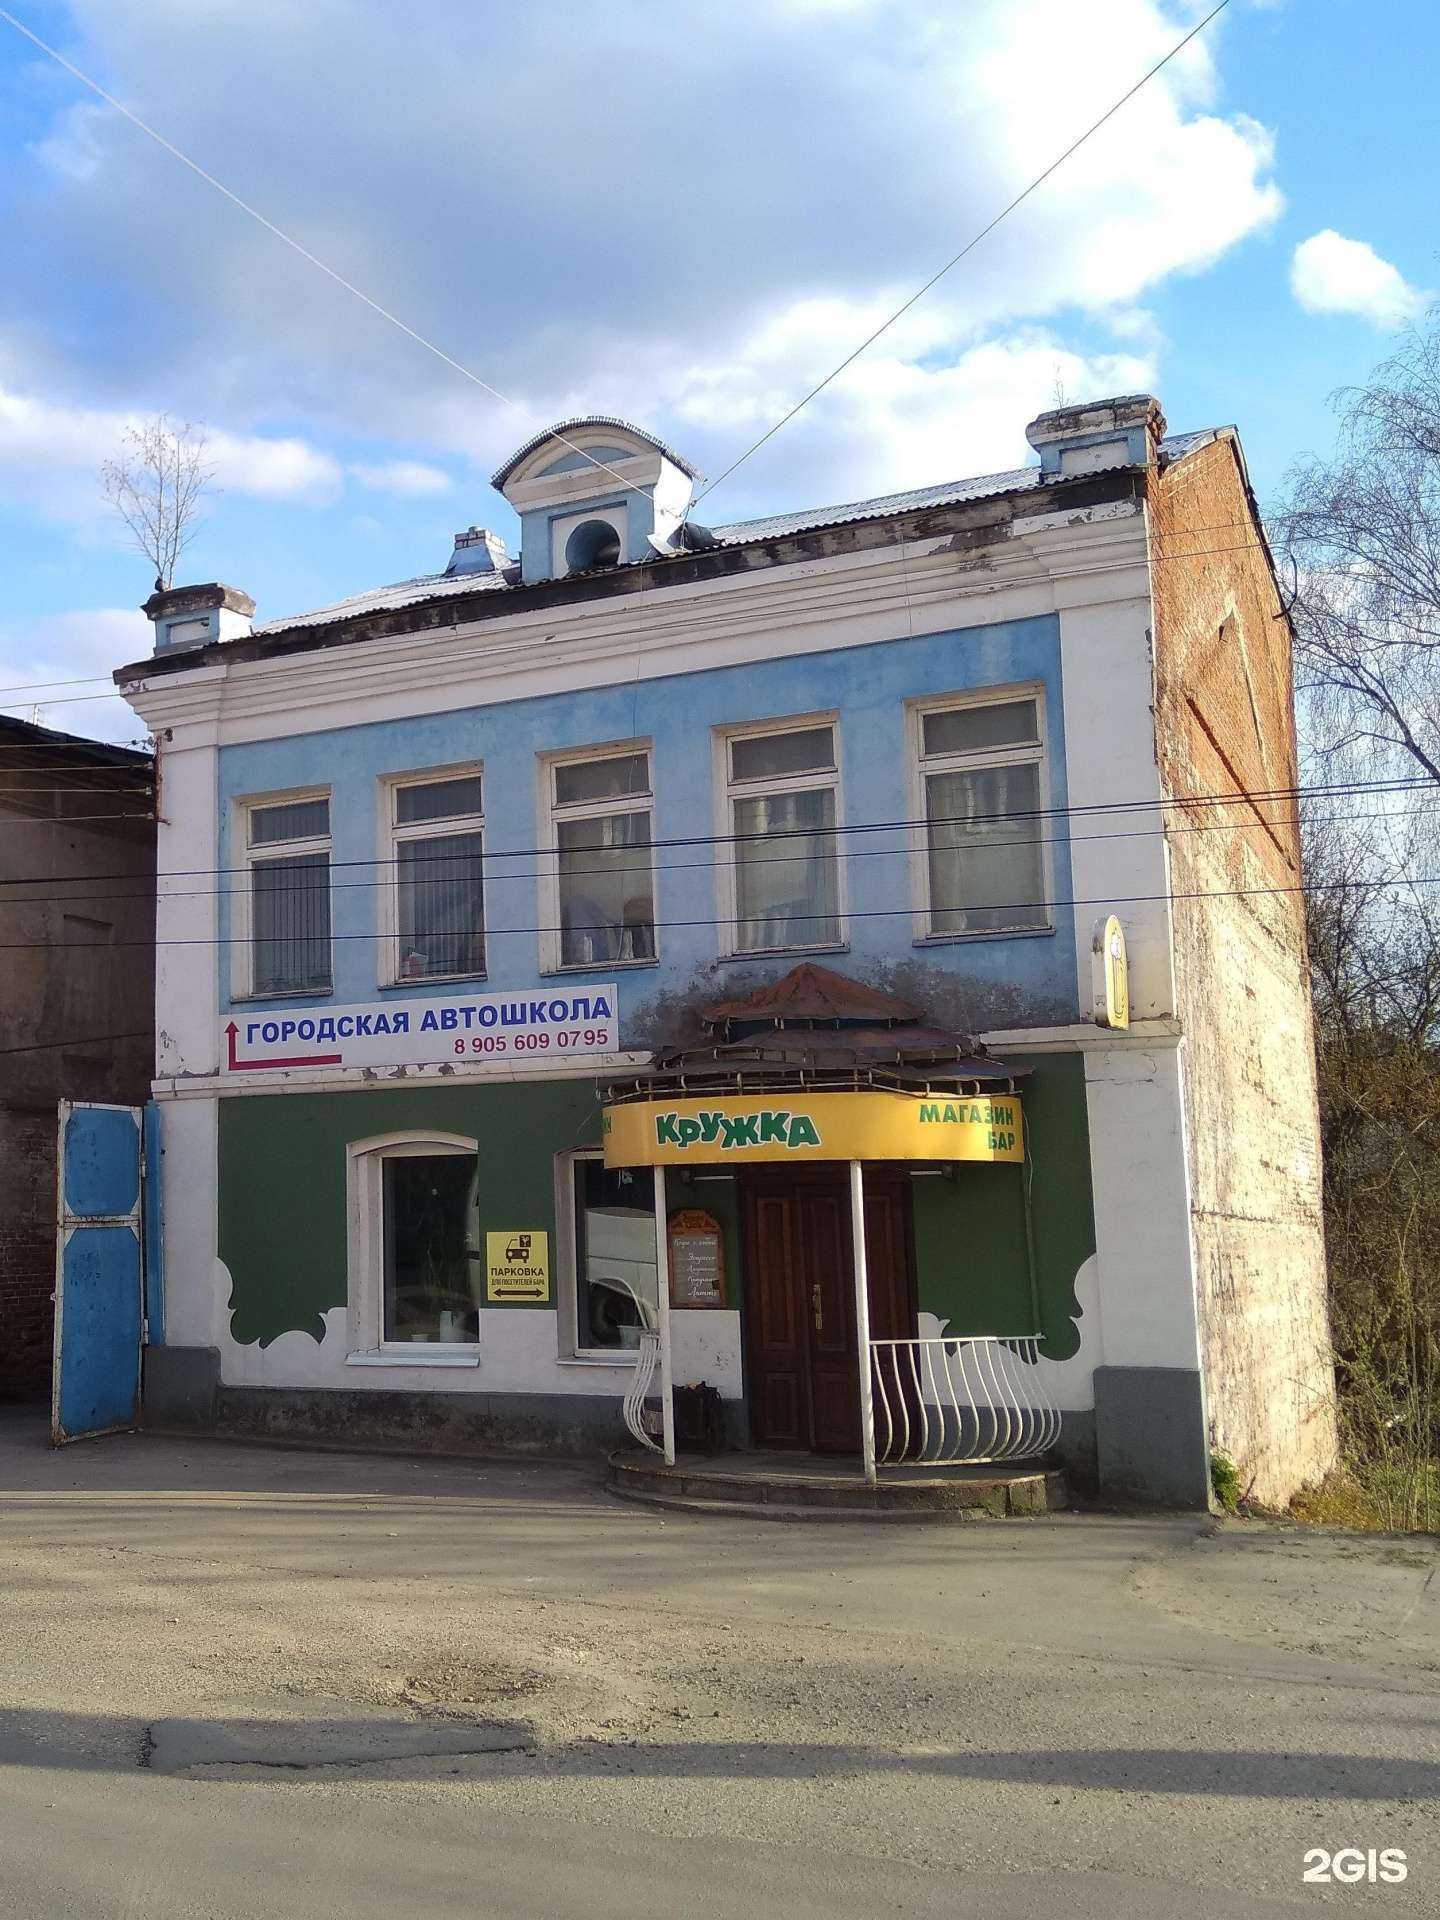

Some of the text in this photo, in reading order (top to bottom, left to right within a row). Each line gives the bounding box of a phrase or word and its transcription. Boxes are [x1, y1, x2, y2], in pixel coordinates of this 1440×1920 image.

[247, 996, 612, 1044] ГОРОДСКАЯ АВТОШКОЛА
[454, 1038, 466, 1054] 8
[472, 1035, 507, 1053] 905
[514, 1033, 550, 1050] 609
[919, 1104, 1013, 1126] МАГАЗИН
[655, 1111, 822, 1149] КРУЖКА
[988, 1131, 1016, 1151] БАР
[491, 1267, 545, 1276] ПАРКОВКА
